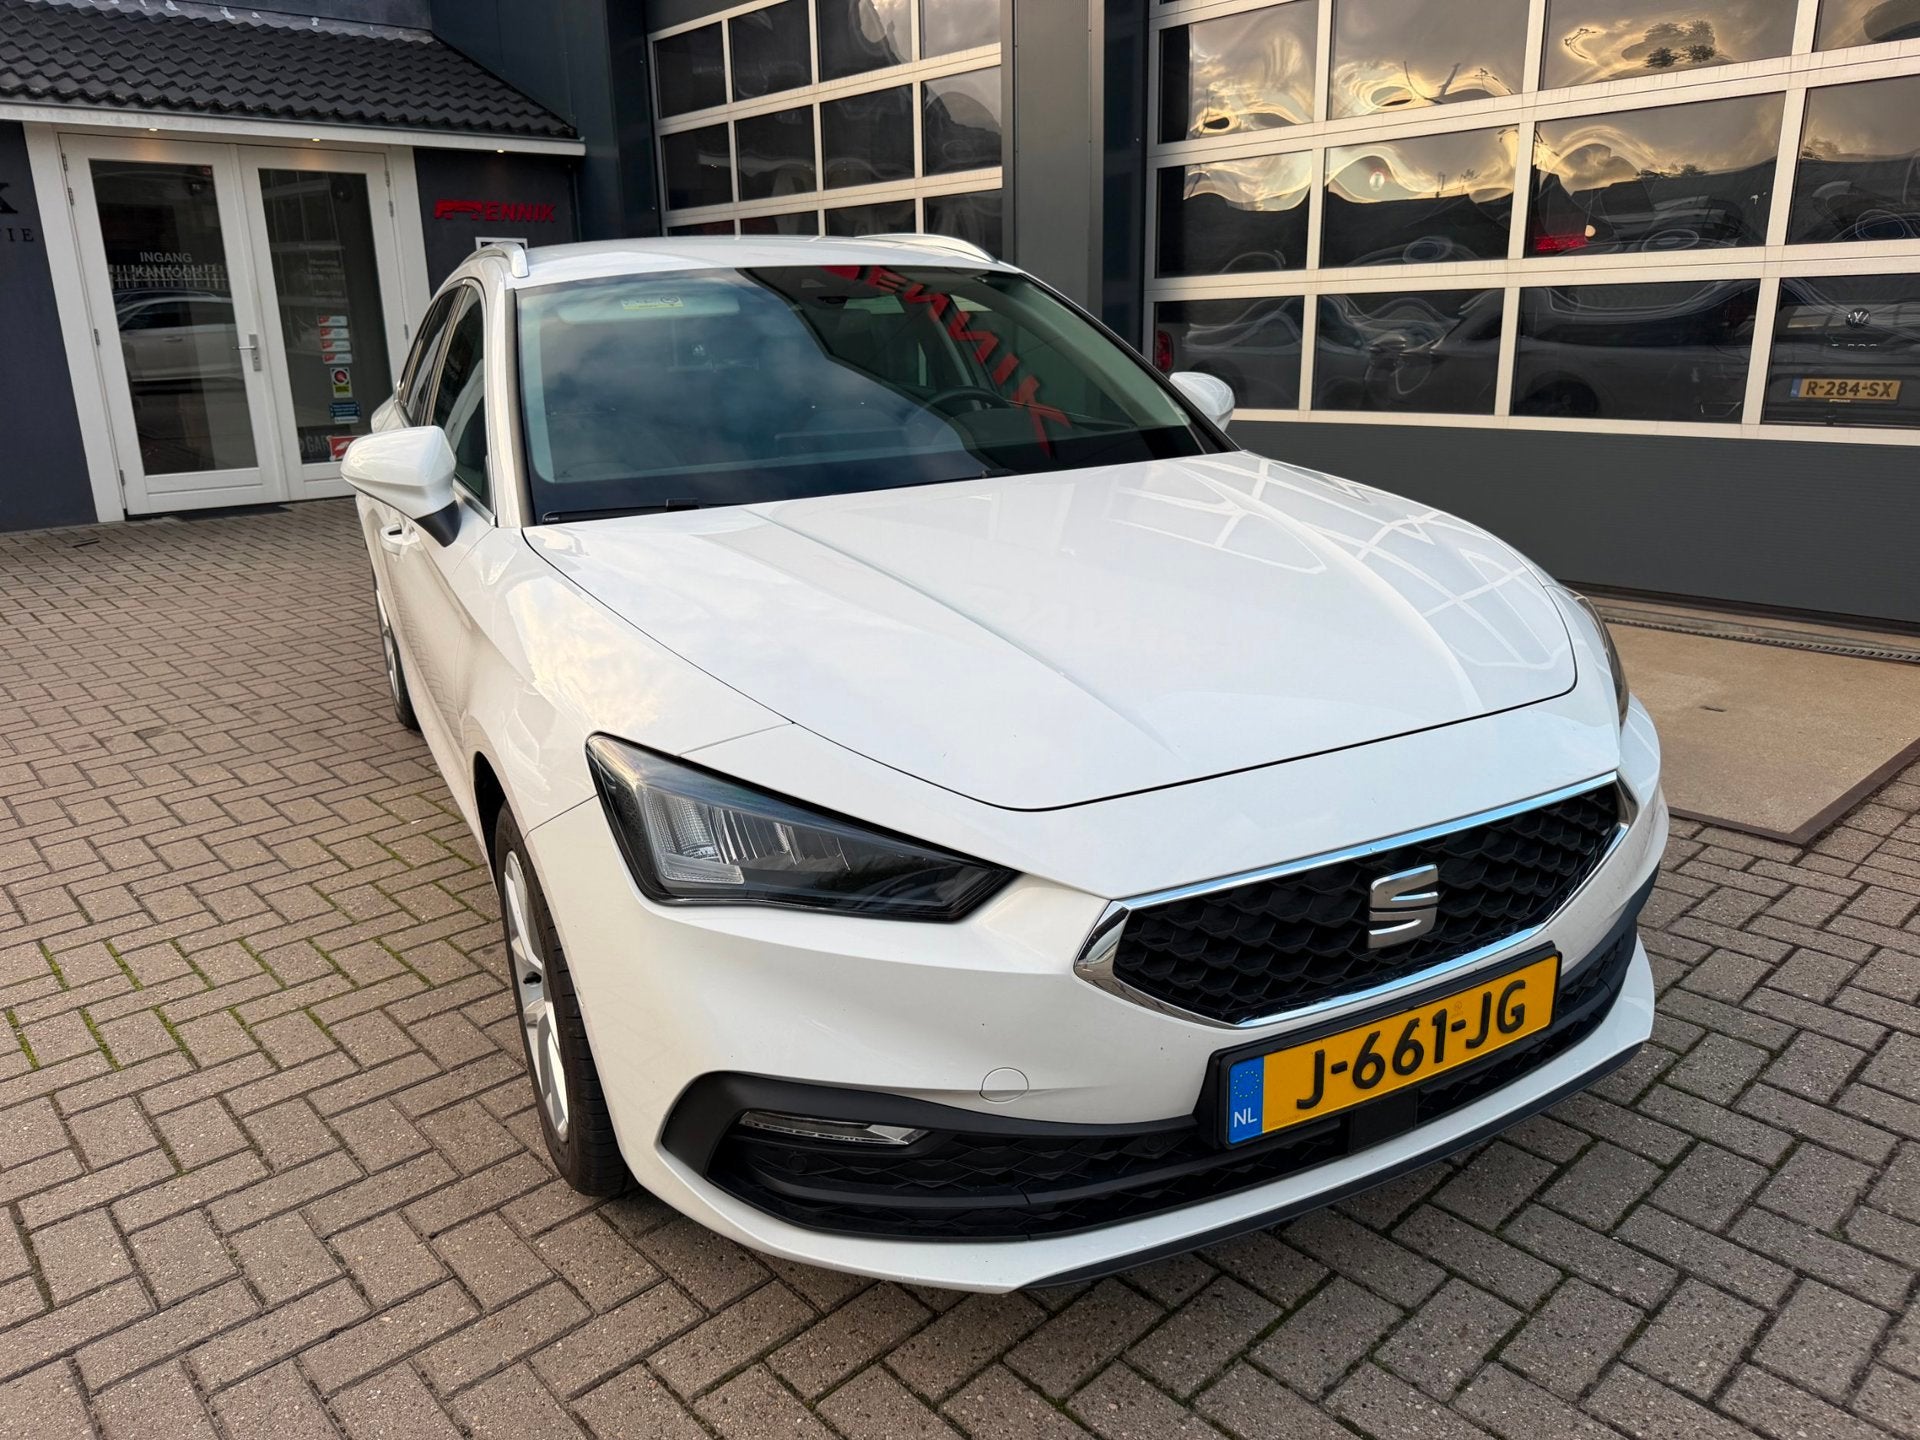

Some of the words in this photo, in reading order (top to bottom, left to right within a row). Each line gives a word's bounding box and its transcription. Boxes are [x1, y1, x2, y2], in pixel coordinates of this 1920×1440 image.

[140, 251, 193, 263] INGANG
[1805, 380, 1894, 398] R-284-SX
[1296, 979, 1527, 1111] J-661-JG
[1233, 1108, 1258, 1128] NL
